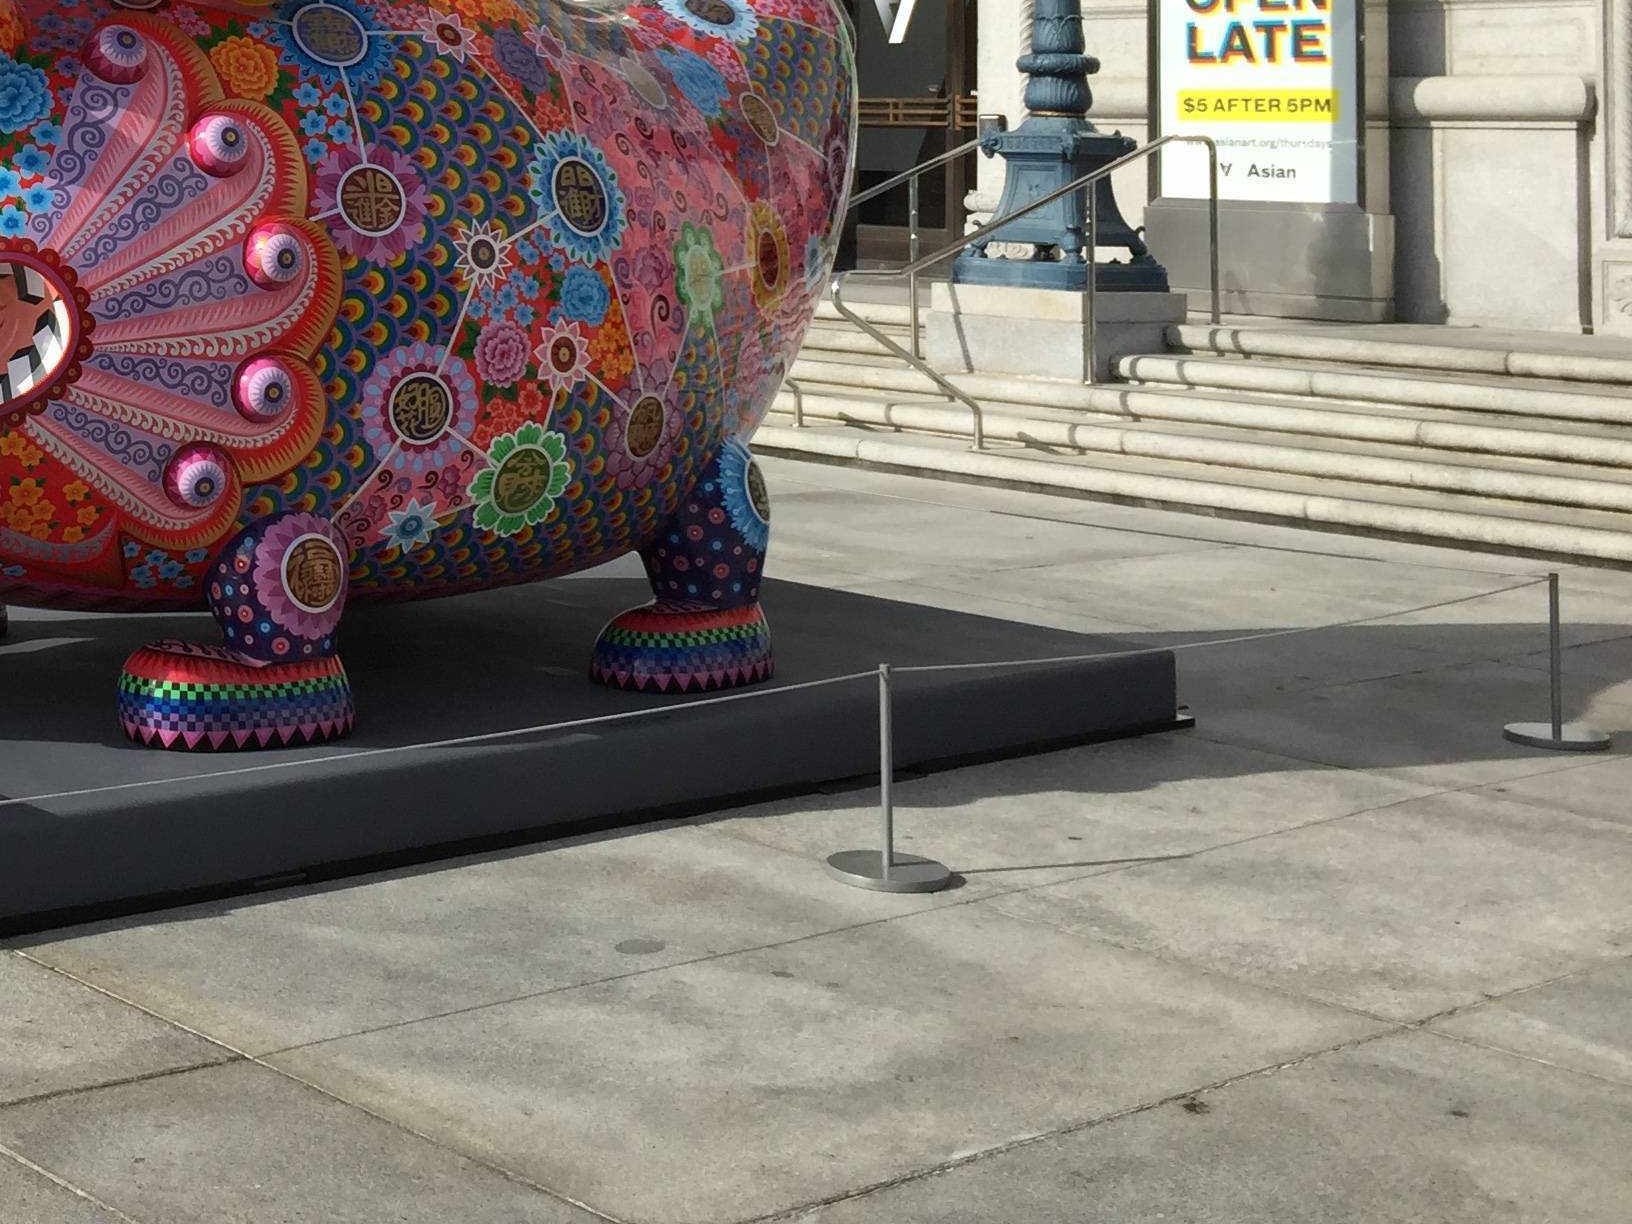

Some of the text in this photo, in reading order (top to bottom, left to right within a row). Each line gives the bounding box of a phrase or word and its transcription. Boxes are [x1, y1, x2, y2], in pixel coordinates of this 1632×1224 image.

[1186, 19, 1331, 64] LATE
[1183, 97, 1332, 113] $5 AFTER 5PM
[1247, 163, 1296, 178] Asian
